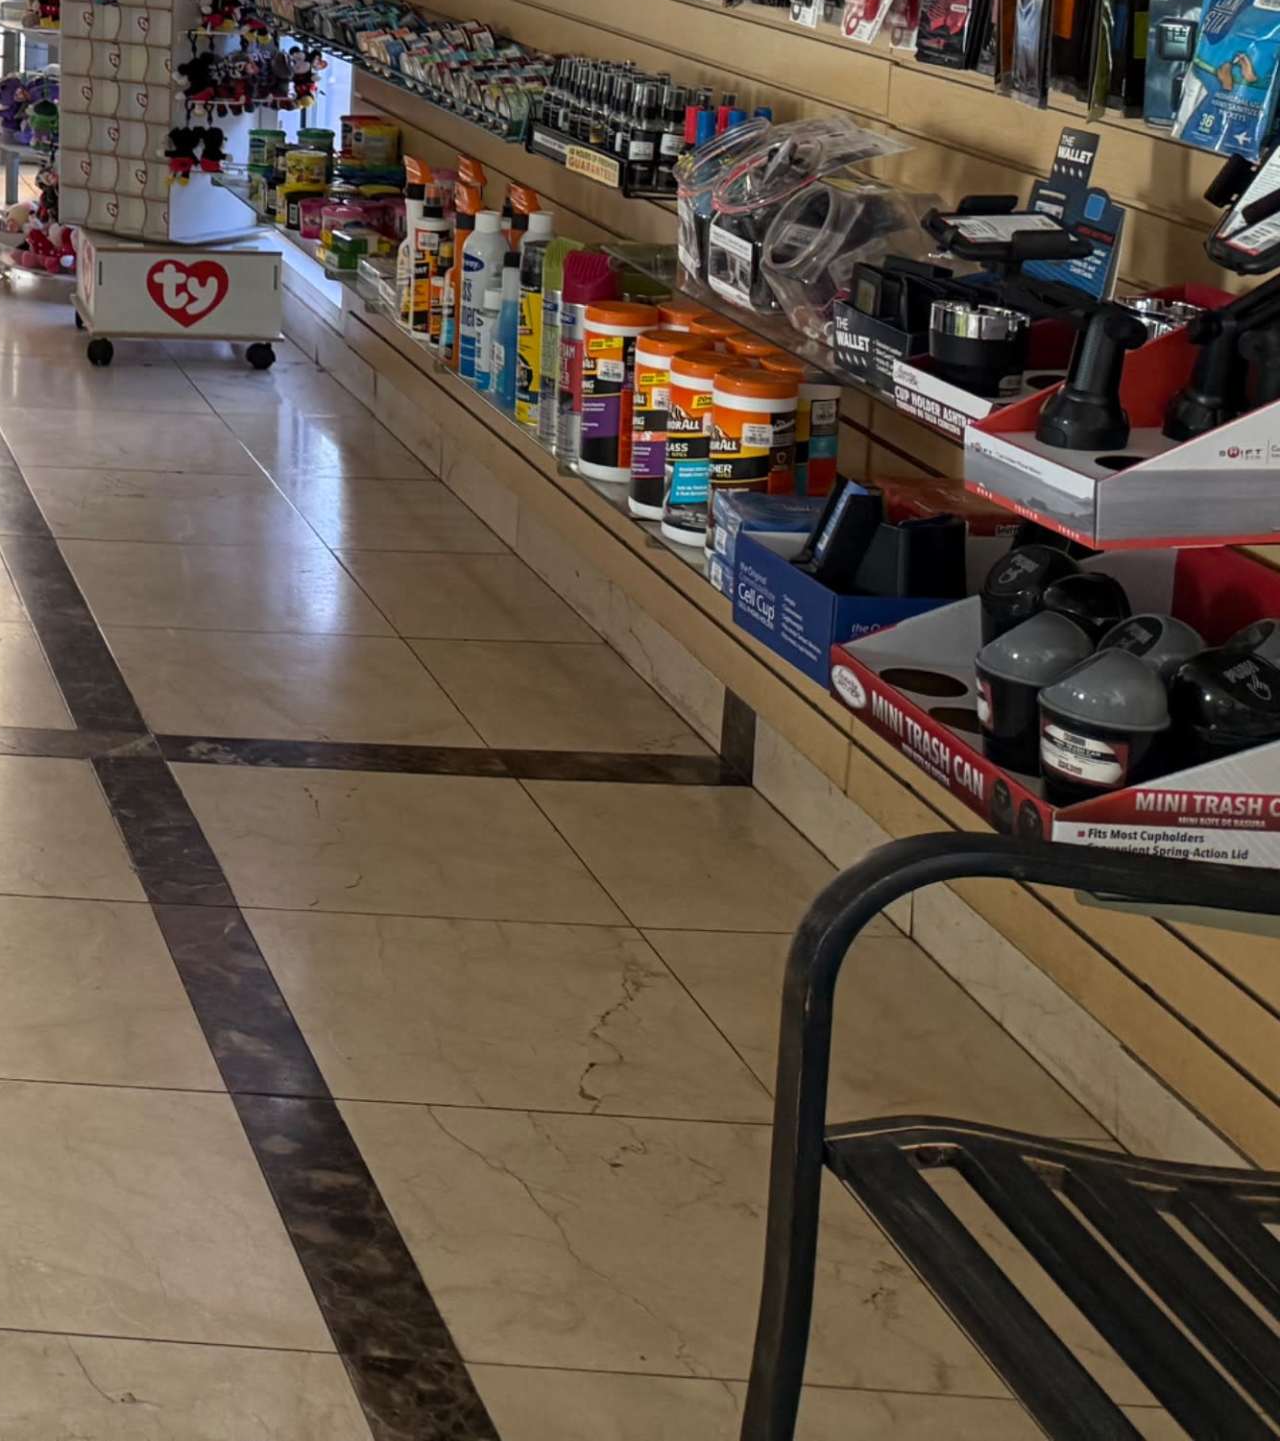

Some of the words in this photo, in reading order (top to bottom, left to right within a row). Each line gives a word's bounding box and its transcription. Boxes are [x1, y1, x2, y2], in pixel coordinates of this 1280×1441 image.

[1061, 134, 1076, 147] THE
[1057, 145, 1094, 165] WALLET
[153, 263, 219, 315] ty
[836, 316, 849, 331] THE
[836, 330, 870, 353] WALLET
[894, 385, 910, 403] CUP
[911, 392, 942, 414] HOLDER
[666, 442, 689, 452] LASS
[737, 582, 755, 606] Cell
[756, 595, 776, 622] Cup
[851, 624, 869, 633] the
[871, 690, 904, 738] MINI
[905, 716, 951, 773] TRASH
[953, 755, 985, 800] CAN
[1135, 791, 1188, 813] MINI
[1192, 794, 1264, 816] TRASH
[1088, 828, 1107, 839] Fits
[1110, 829, 1139, 841] Most
[1140, 830, 1205, 844] Cupholders
[1231, 848, 1249, 861] Lid
